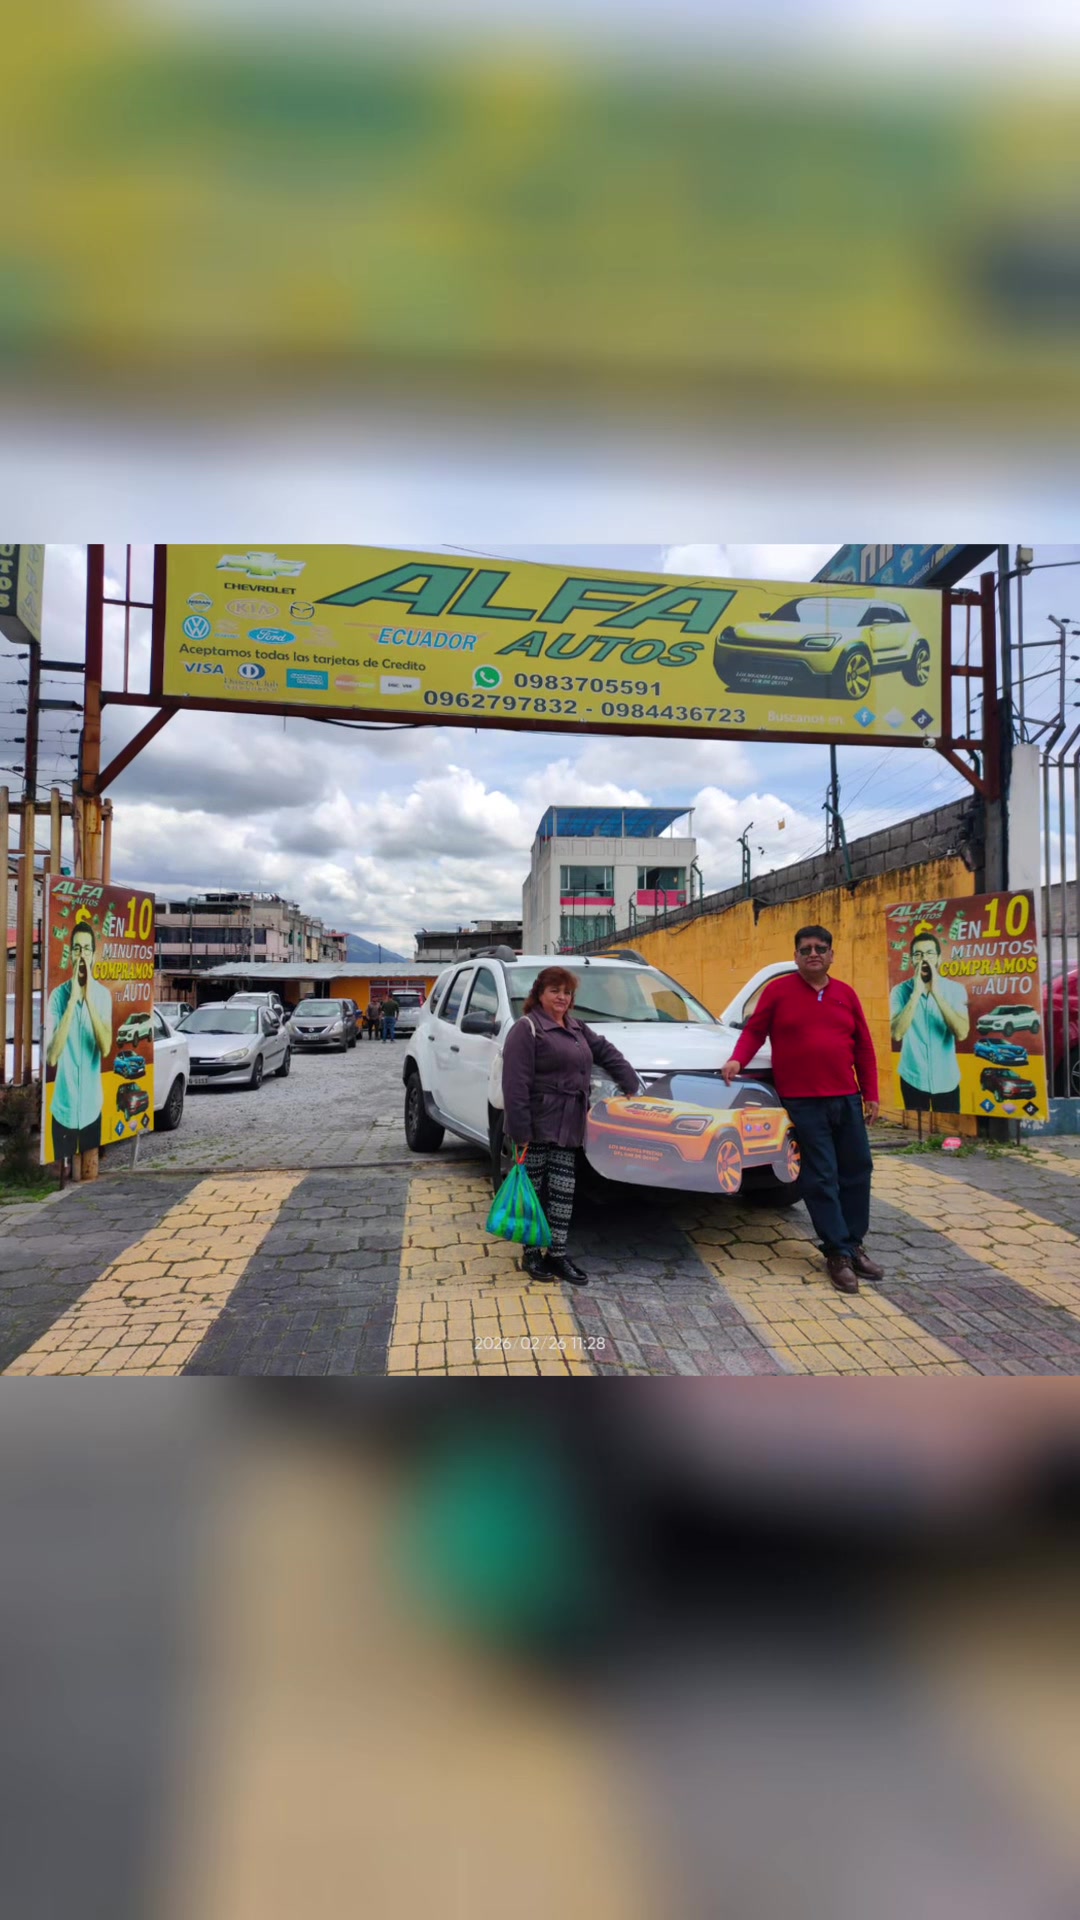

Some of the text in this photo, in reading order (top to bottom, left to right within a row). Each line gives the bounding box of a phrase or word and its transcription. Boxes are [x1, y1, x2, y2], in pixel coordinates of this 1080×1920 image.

[224, 582, 296, 595] CHEVROLET
[312, 562, 738, 634] ALFA
[235, 604, 271, 616] KIA
[256, 629, 287, 642] Ford
[378, 628, 478, 651] ECUADOR
[179, 644, 426, 671] Aceptamos todas las tarjetas de Credito
[495, 631, 704, 666] AUTOS
[184, 662, 224, 674] VISA
[514, 673, 660, 696] 0983705591
[424, 690, 577, 714] 0962797832
[602, 702, 746, 724] 0984436723
[768, 710, 824, 724] Buscanos
[52, 880, 103, 898] ALFA
[75, 896, 99, 906] AUTOS
[888, 900, 947, 918] ALFA
[109, 897, 153, 940] EN 10
[958, 895, 1030, 940] EN 10
[103, 943, 153, 959] MINUTOS
[951, 940, 1034, 959] MINUTOS
[93, 962, 154, 980] COMPRAMOS
[940, 956, 1038, 977] COMPRAMOS
[123, 983, 150, 1002] AUTO
[972, 976, 1033, 994] TU AUTO
[624, 1103, 674, 1113] ALFA
